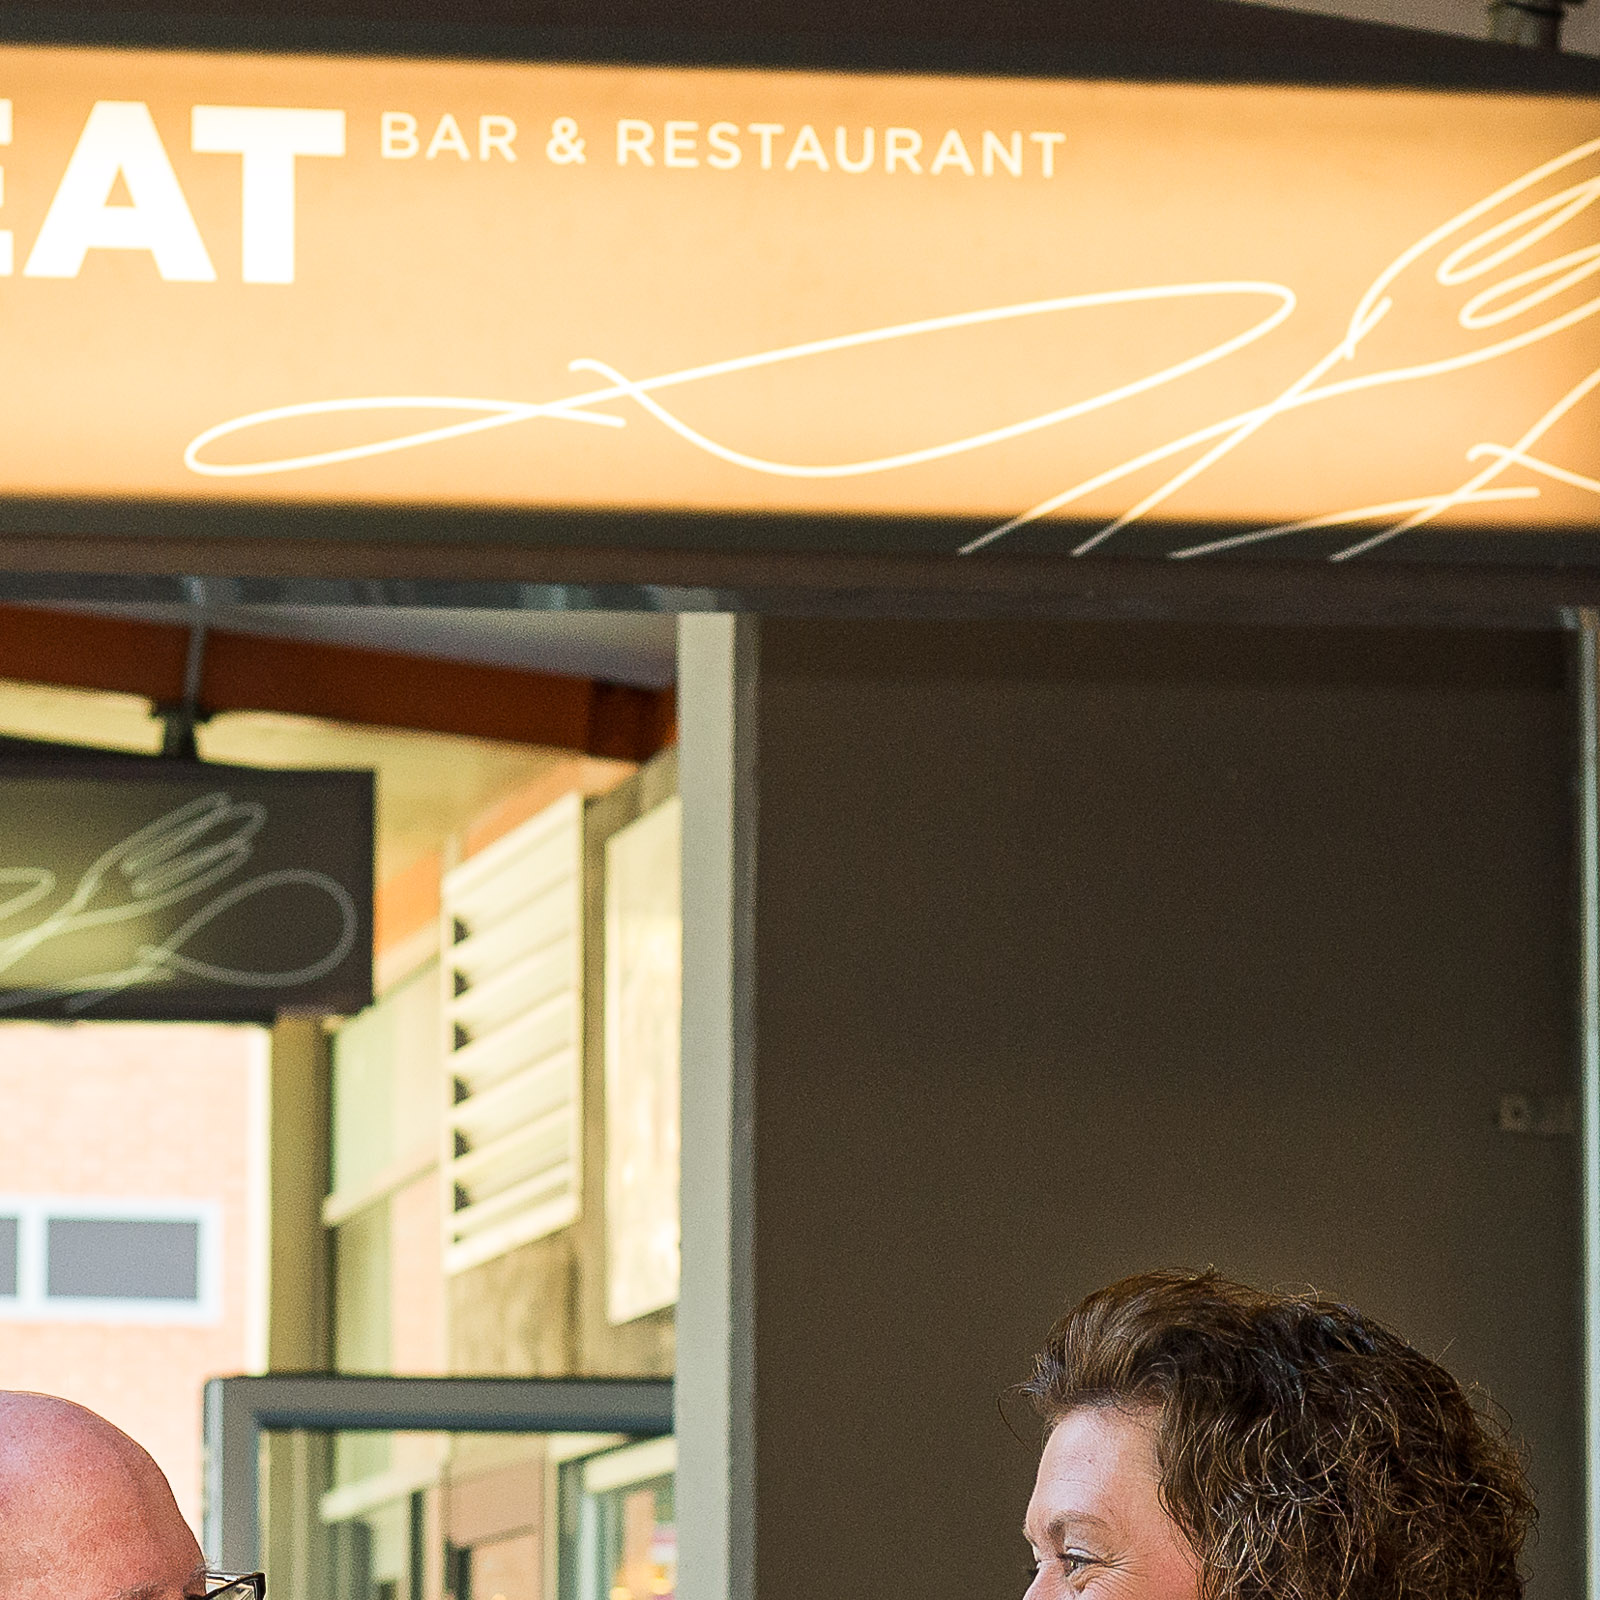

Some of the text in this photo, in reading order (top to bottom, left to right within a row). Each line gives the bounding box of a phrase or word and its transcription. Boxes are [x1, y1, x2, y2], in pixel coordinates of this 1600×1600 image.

[380, 111, 518, 163] BAR
[546, 116, 589, 165] &
[617, 120, 1067, 178] RESTAURANT
